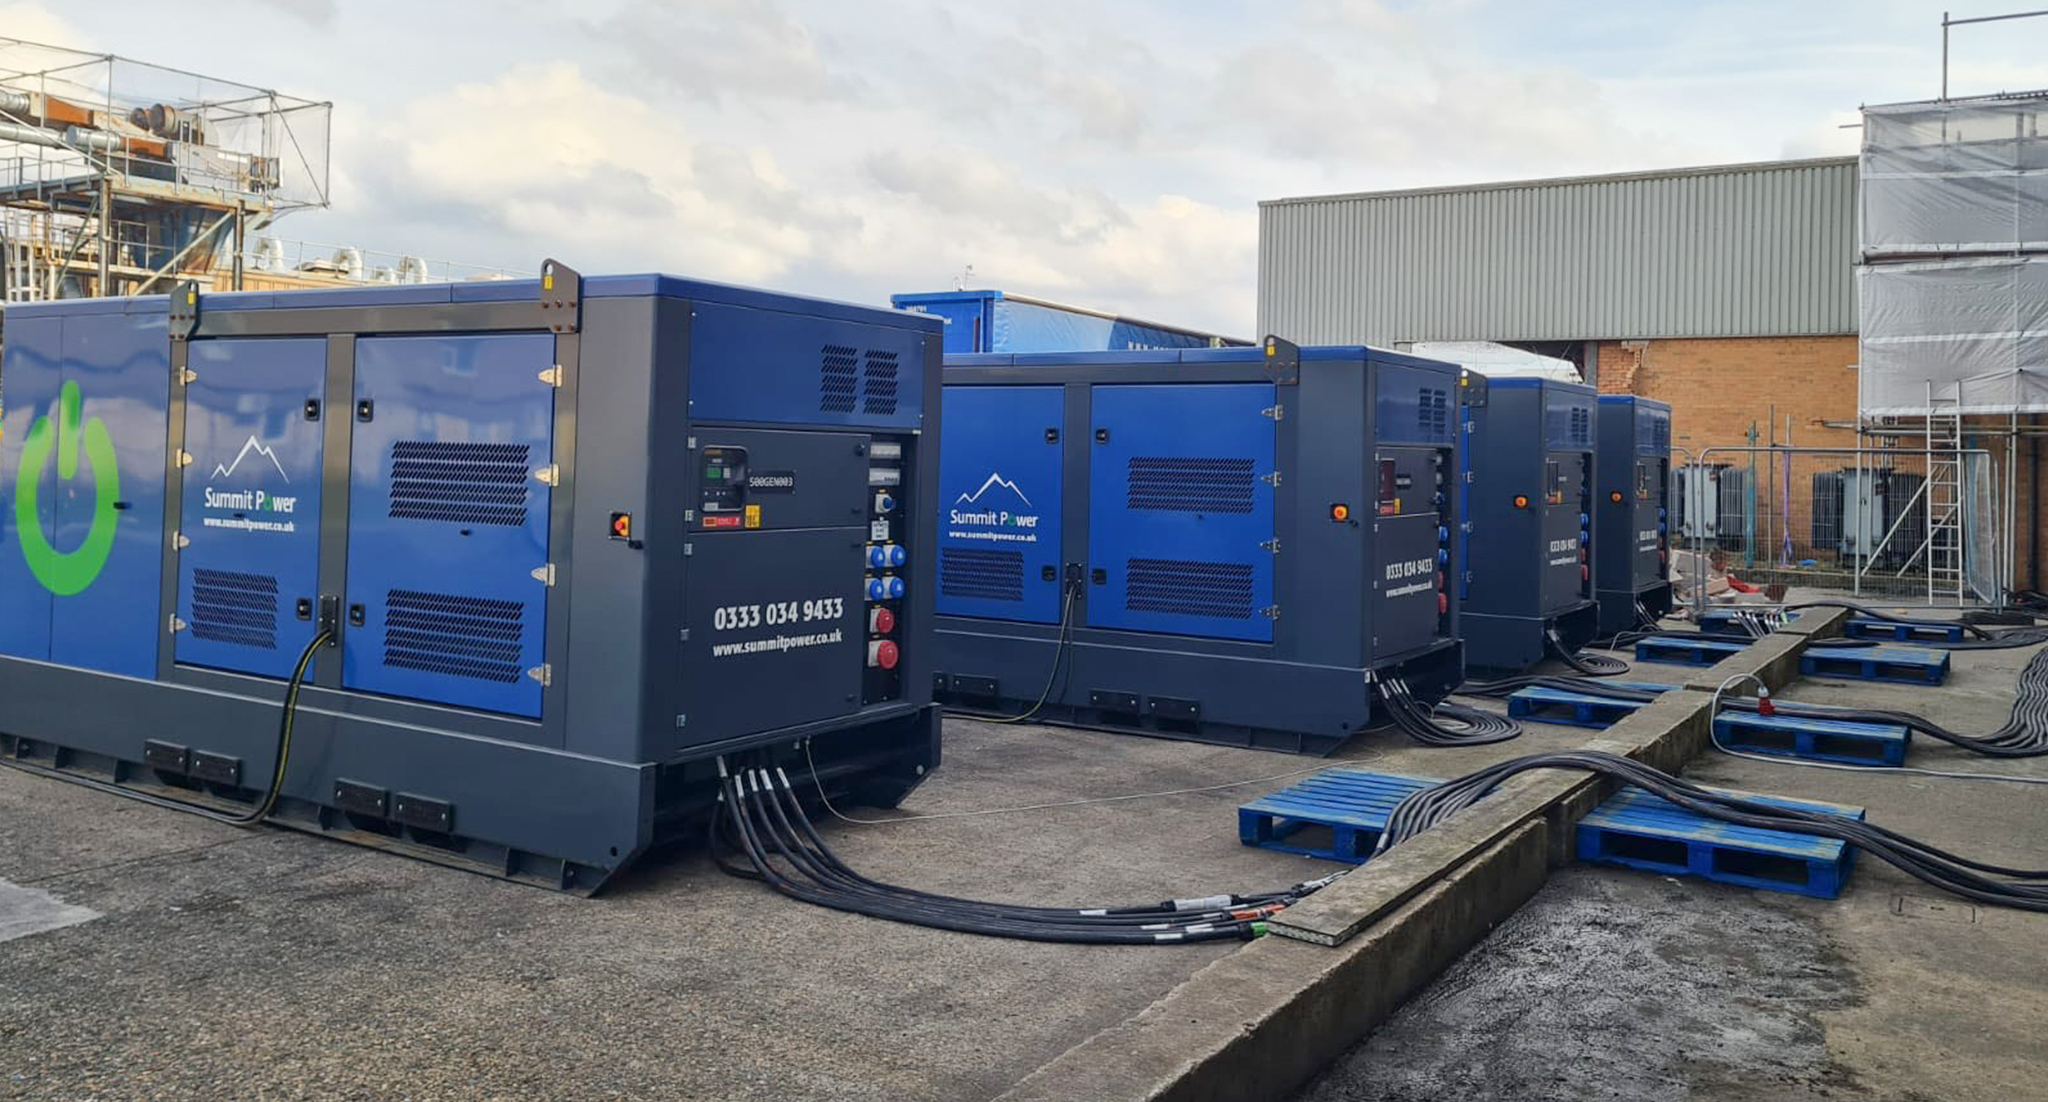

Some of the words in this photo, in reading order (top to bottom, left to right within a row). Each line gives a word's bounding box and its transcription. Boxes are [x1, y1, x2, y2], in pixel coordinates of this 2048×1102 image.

[749, 476, 794, 487] 500GEN003
[204, 487, 253, 510] Summit
[255, 490, 297, 513] Power
[203, 517, 295, 533] www.summitpower.co.uk
[950, 509, 997, 526] Summit
[1000, 511, 1039, 528] Power
[1386, 562, 1403, 580] 0333
[1404, 560, 1416, 577] 034
[1417, 558, 1433, 575] 9433
[714, 605, 761, 631] 0333
[766, 601, 798, 625] 034
[803, 597, 843, 621] 9433
[713, 628, 842, 657] www.summitpower.co.uk
